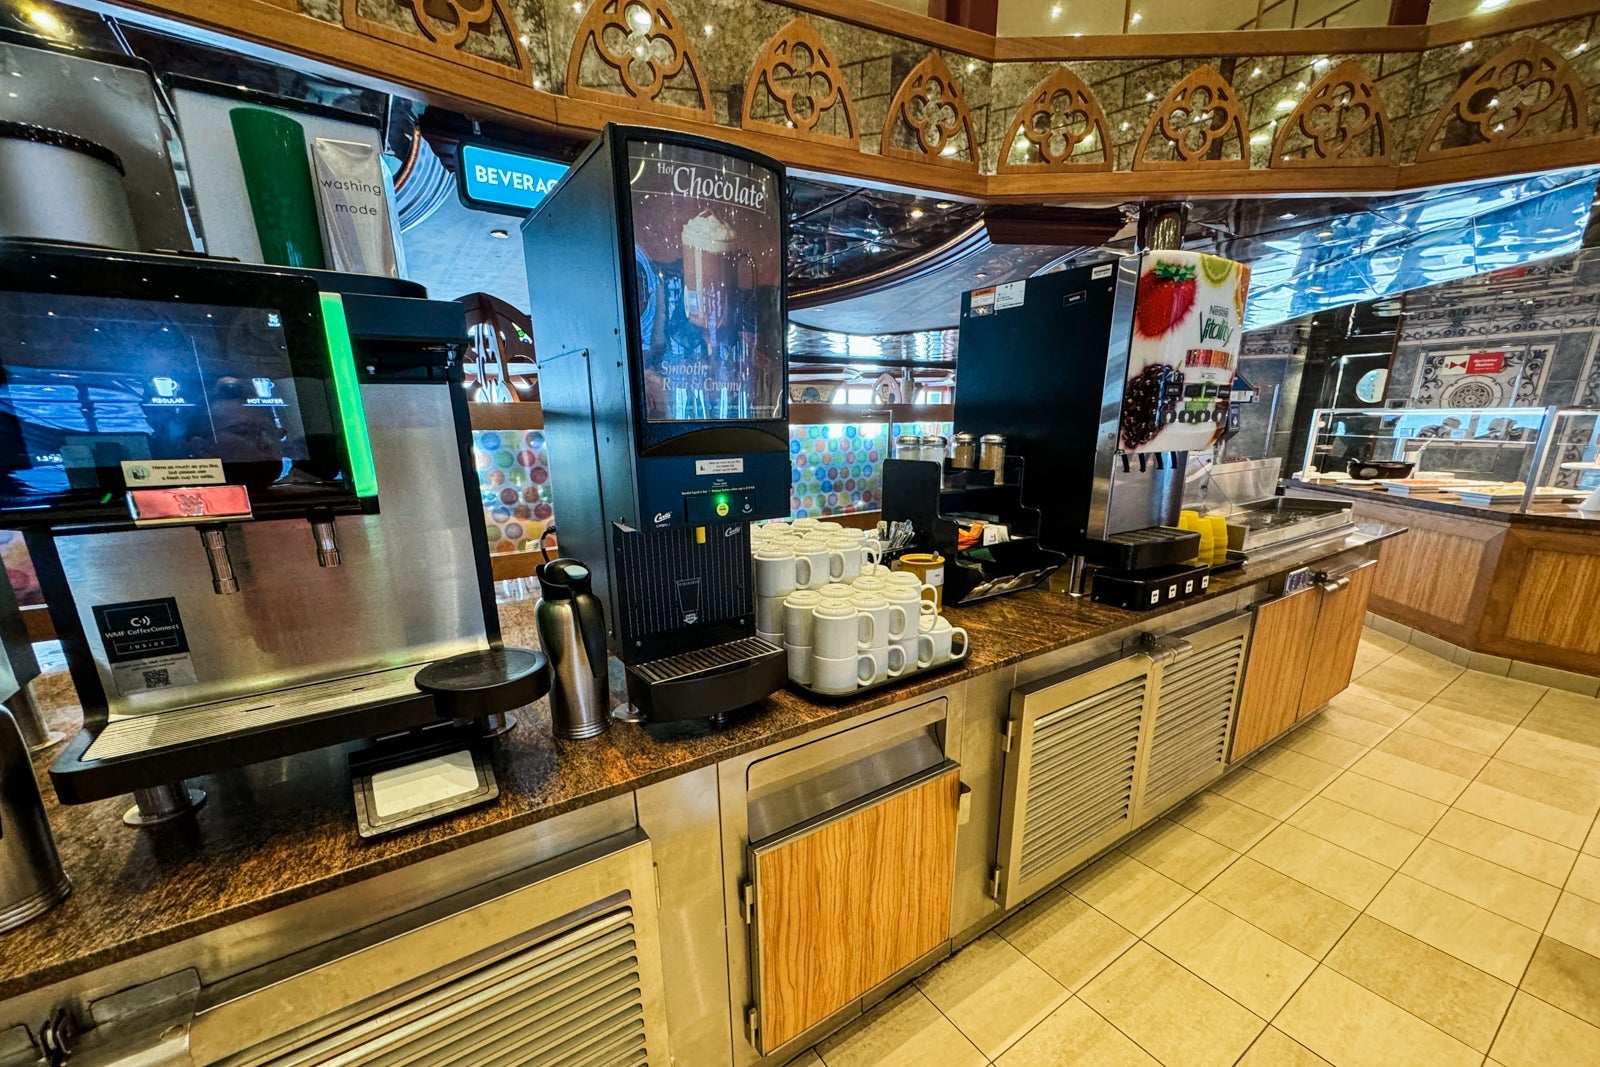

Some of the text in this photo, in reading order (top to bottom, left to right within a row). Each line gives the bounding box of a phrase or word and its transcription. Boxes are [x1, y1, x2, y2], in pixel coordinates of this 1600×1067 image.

[320, 180, 382, 196] washing
[657, 161, 764, 209] Hot Chocolate
[335, 203, 377, 216] mode
[1199, 311, 1234, 347] Vitality
[105, 624, 180, 640] WMF CoffeeConnect
